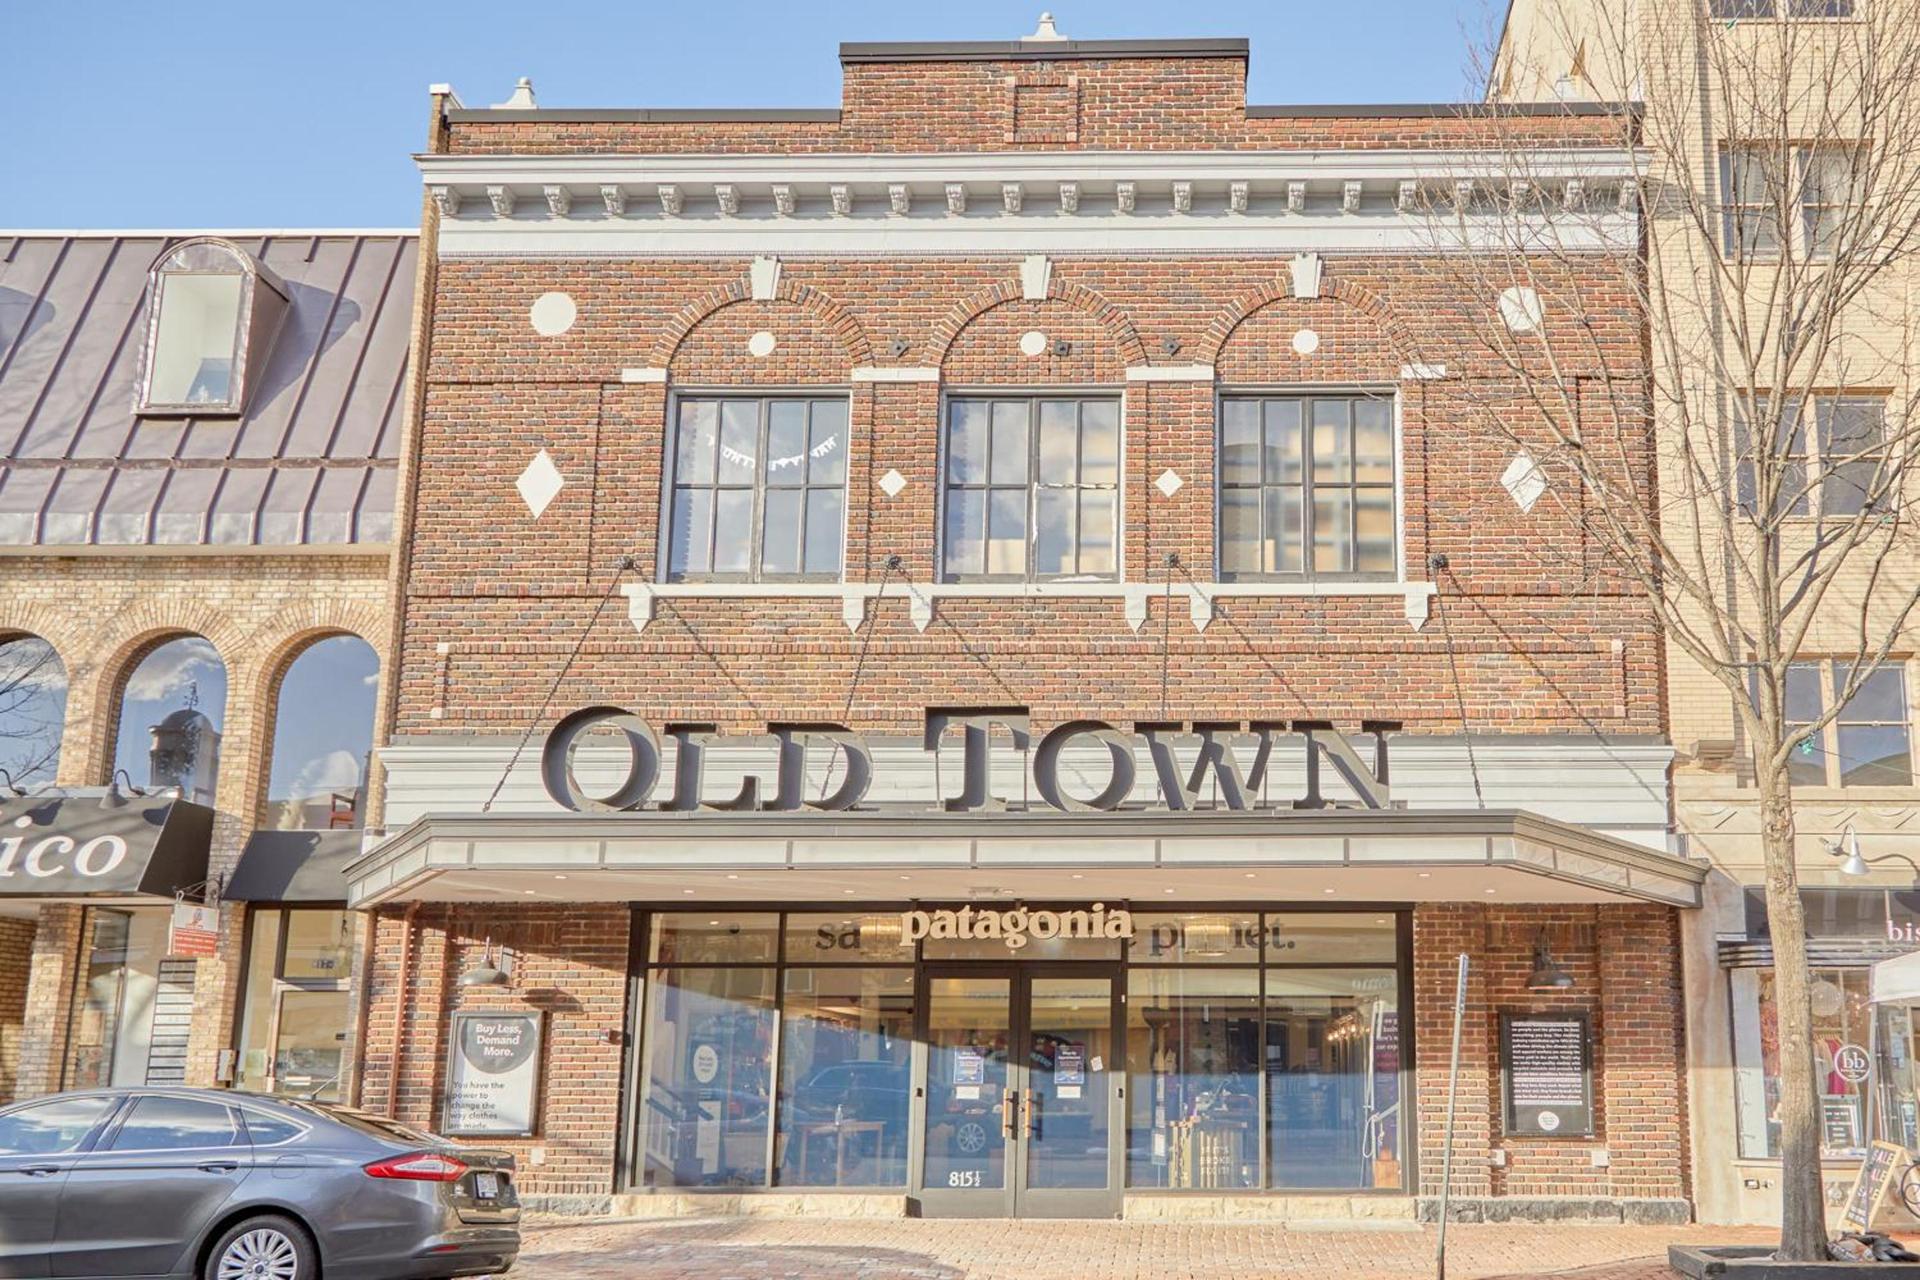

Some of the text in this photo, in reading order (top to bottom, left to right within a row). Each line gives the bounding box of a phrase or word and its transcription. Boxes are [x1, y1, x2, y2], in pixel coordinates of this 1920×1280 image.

[541, 706, 1403, 812] OLD TOWN
[899, 902, 1133, 948] patagonia
[475, 1023, 522, 1035] Buy Less,
[476, 1035, 520, 1045] Demand
[483, 1047, 514, 1056] More.
[1842, 1051, 1866, 1069] bb
[470, 1080, 490, 1089] have
[491, 1080, 505, 1089] the
[479, 1091, 488, 1099] to
[450, 1102, 496, 1110] change the
[468, 1111, 498, 1120] clothes
